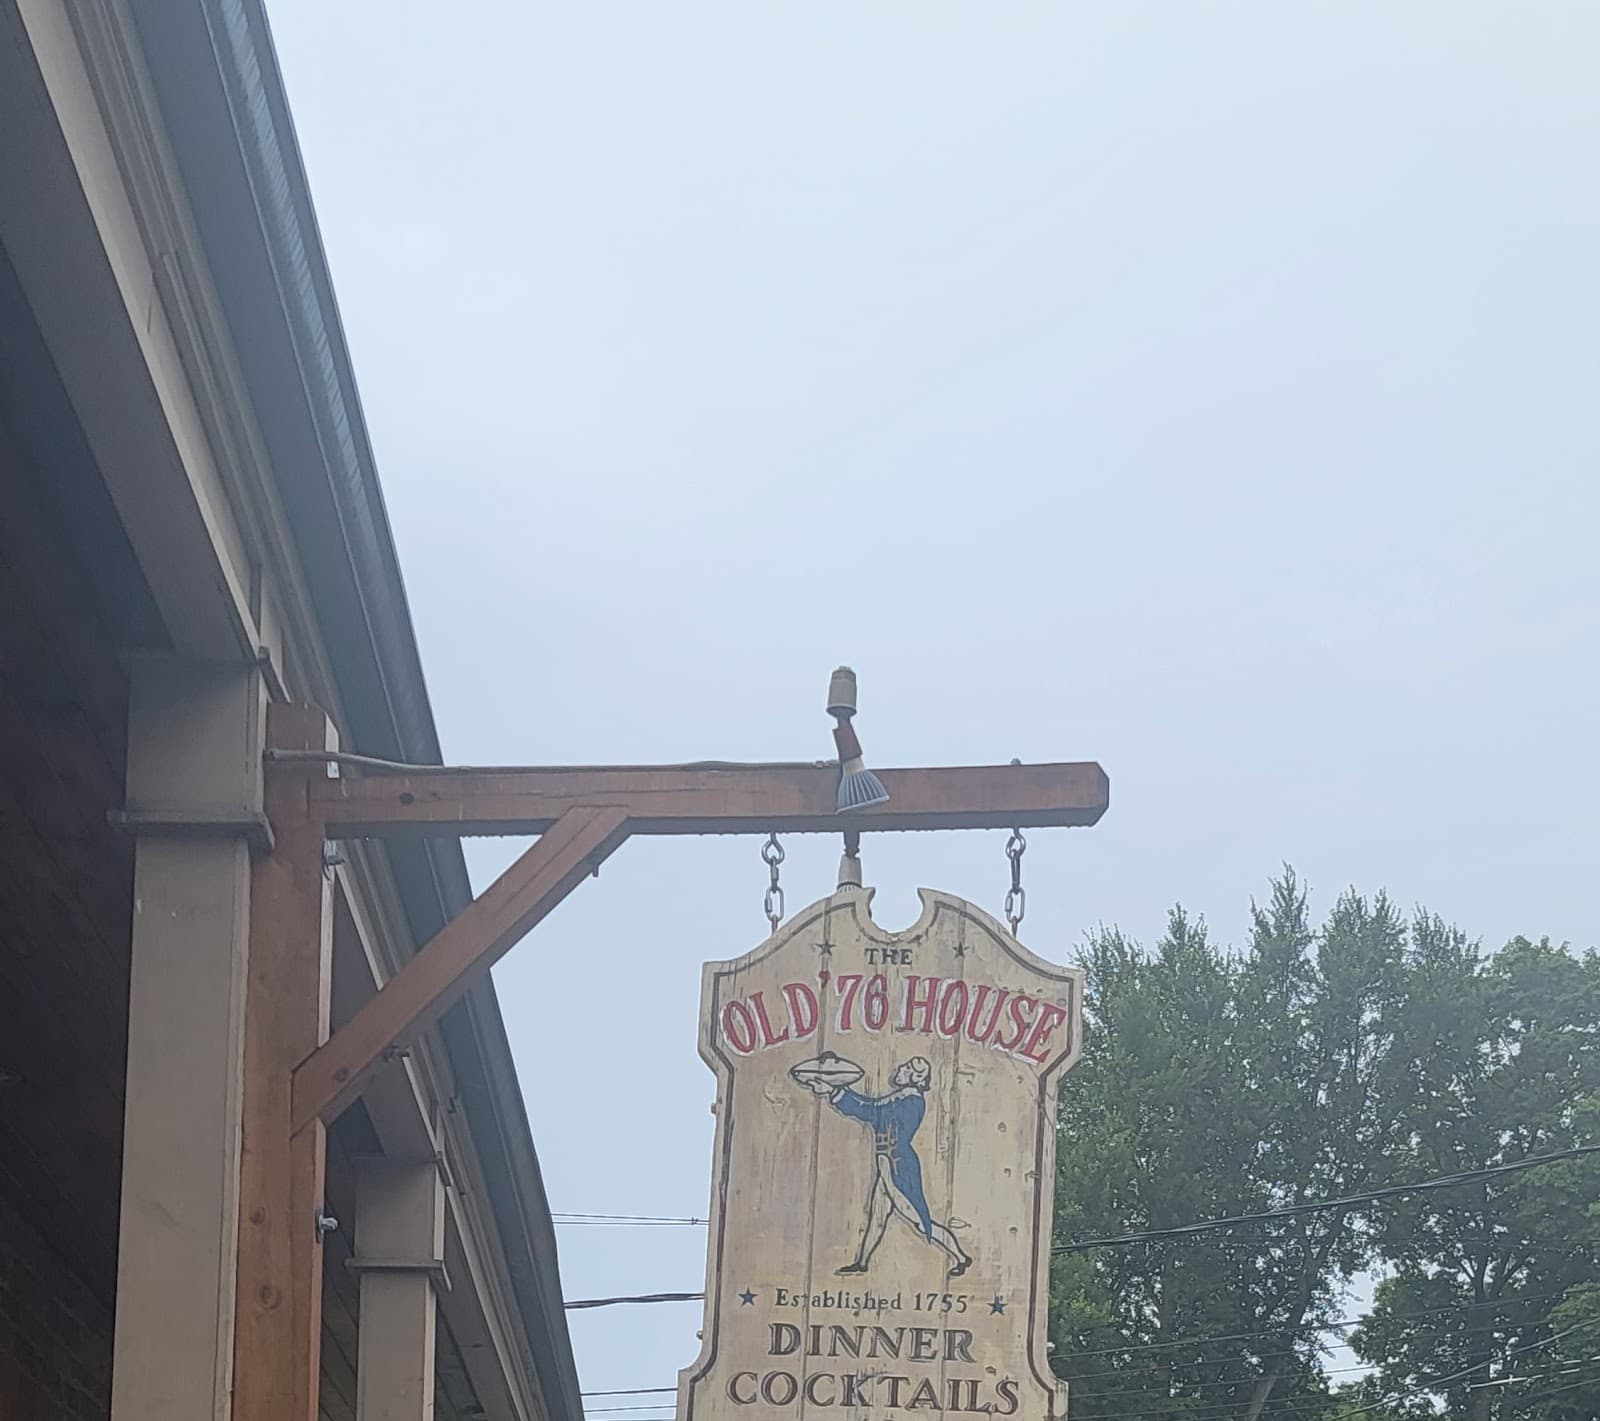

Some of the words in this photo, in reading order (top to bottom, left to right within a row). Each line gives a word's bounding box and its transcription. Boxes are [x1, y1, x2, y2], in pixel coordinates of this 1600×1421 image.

[864, 947, 913, 965] THE
[719, 982, 818, 1055] OLD
[900, 975, 1066, 1065] HOUSE
[775, 1287, 902, 1312] Established
[914, 1293, 969, 1313] 1755
[767, 1322, 976, 1363] DINNER
[726, 1371, 1020, 1415] COCKTAILS
